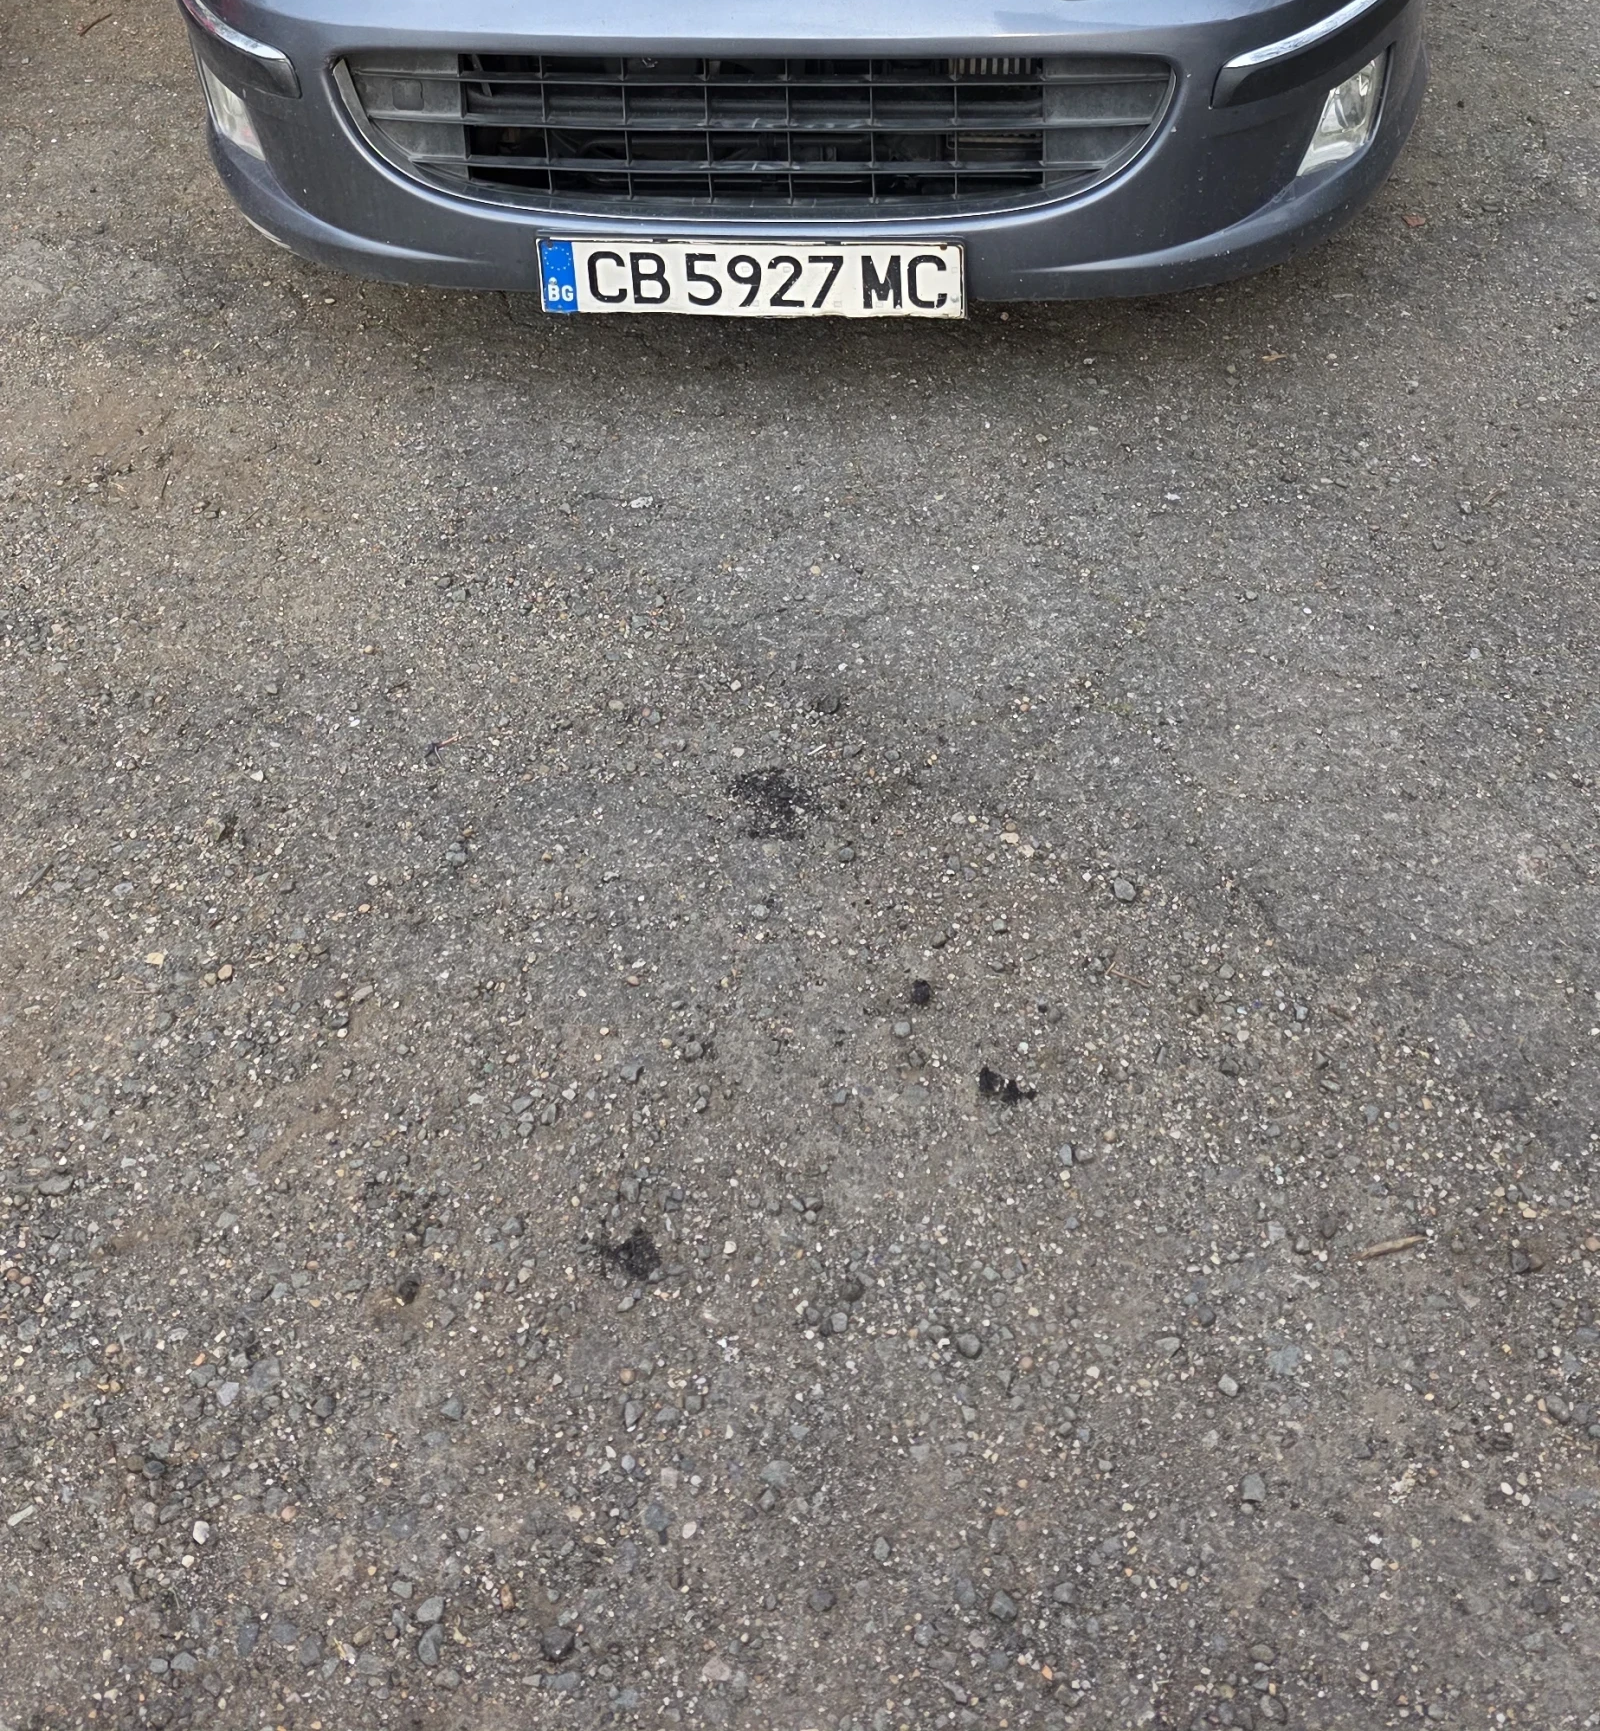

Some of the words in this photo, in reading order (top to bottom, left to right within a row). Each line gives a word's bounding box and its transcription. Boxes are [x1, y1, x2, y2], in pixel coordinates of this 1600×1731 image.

[547, 284, 574, 302] BG
[587, 251, 671, 304] CB
[685, 253, 844, 307] 5927
[862, 255, 948, 309] MC
